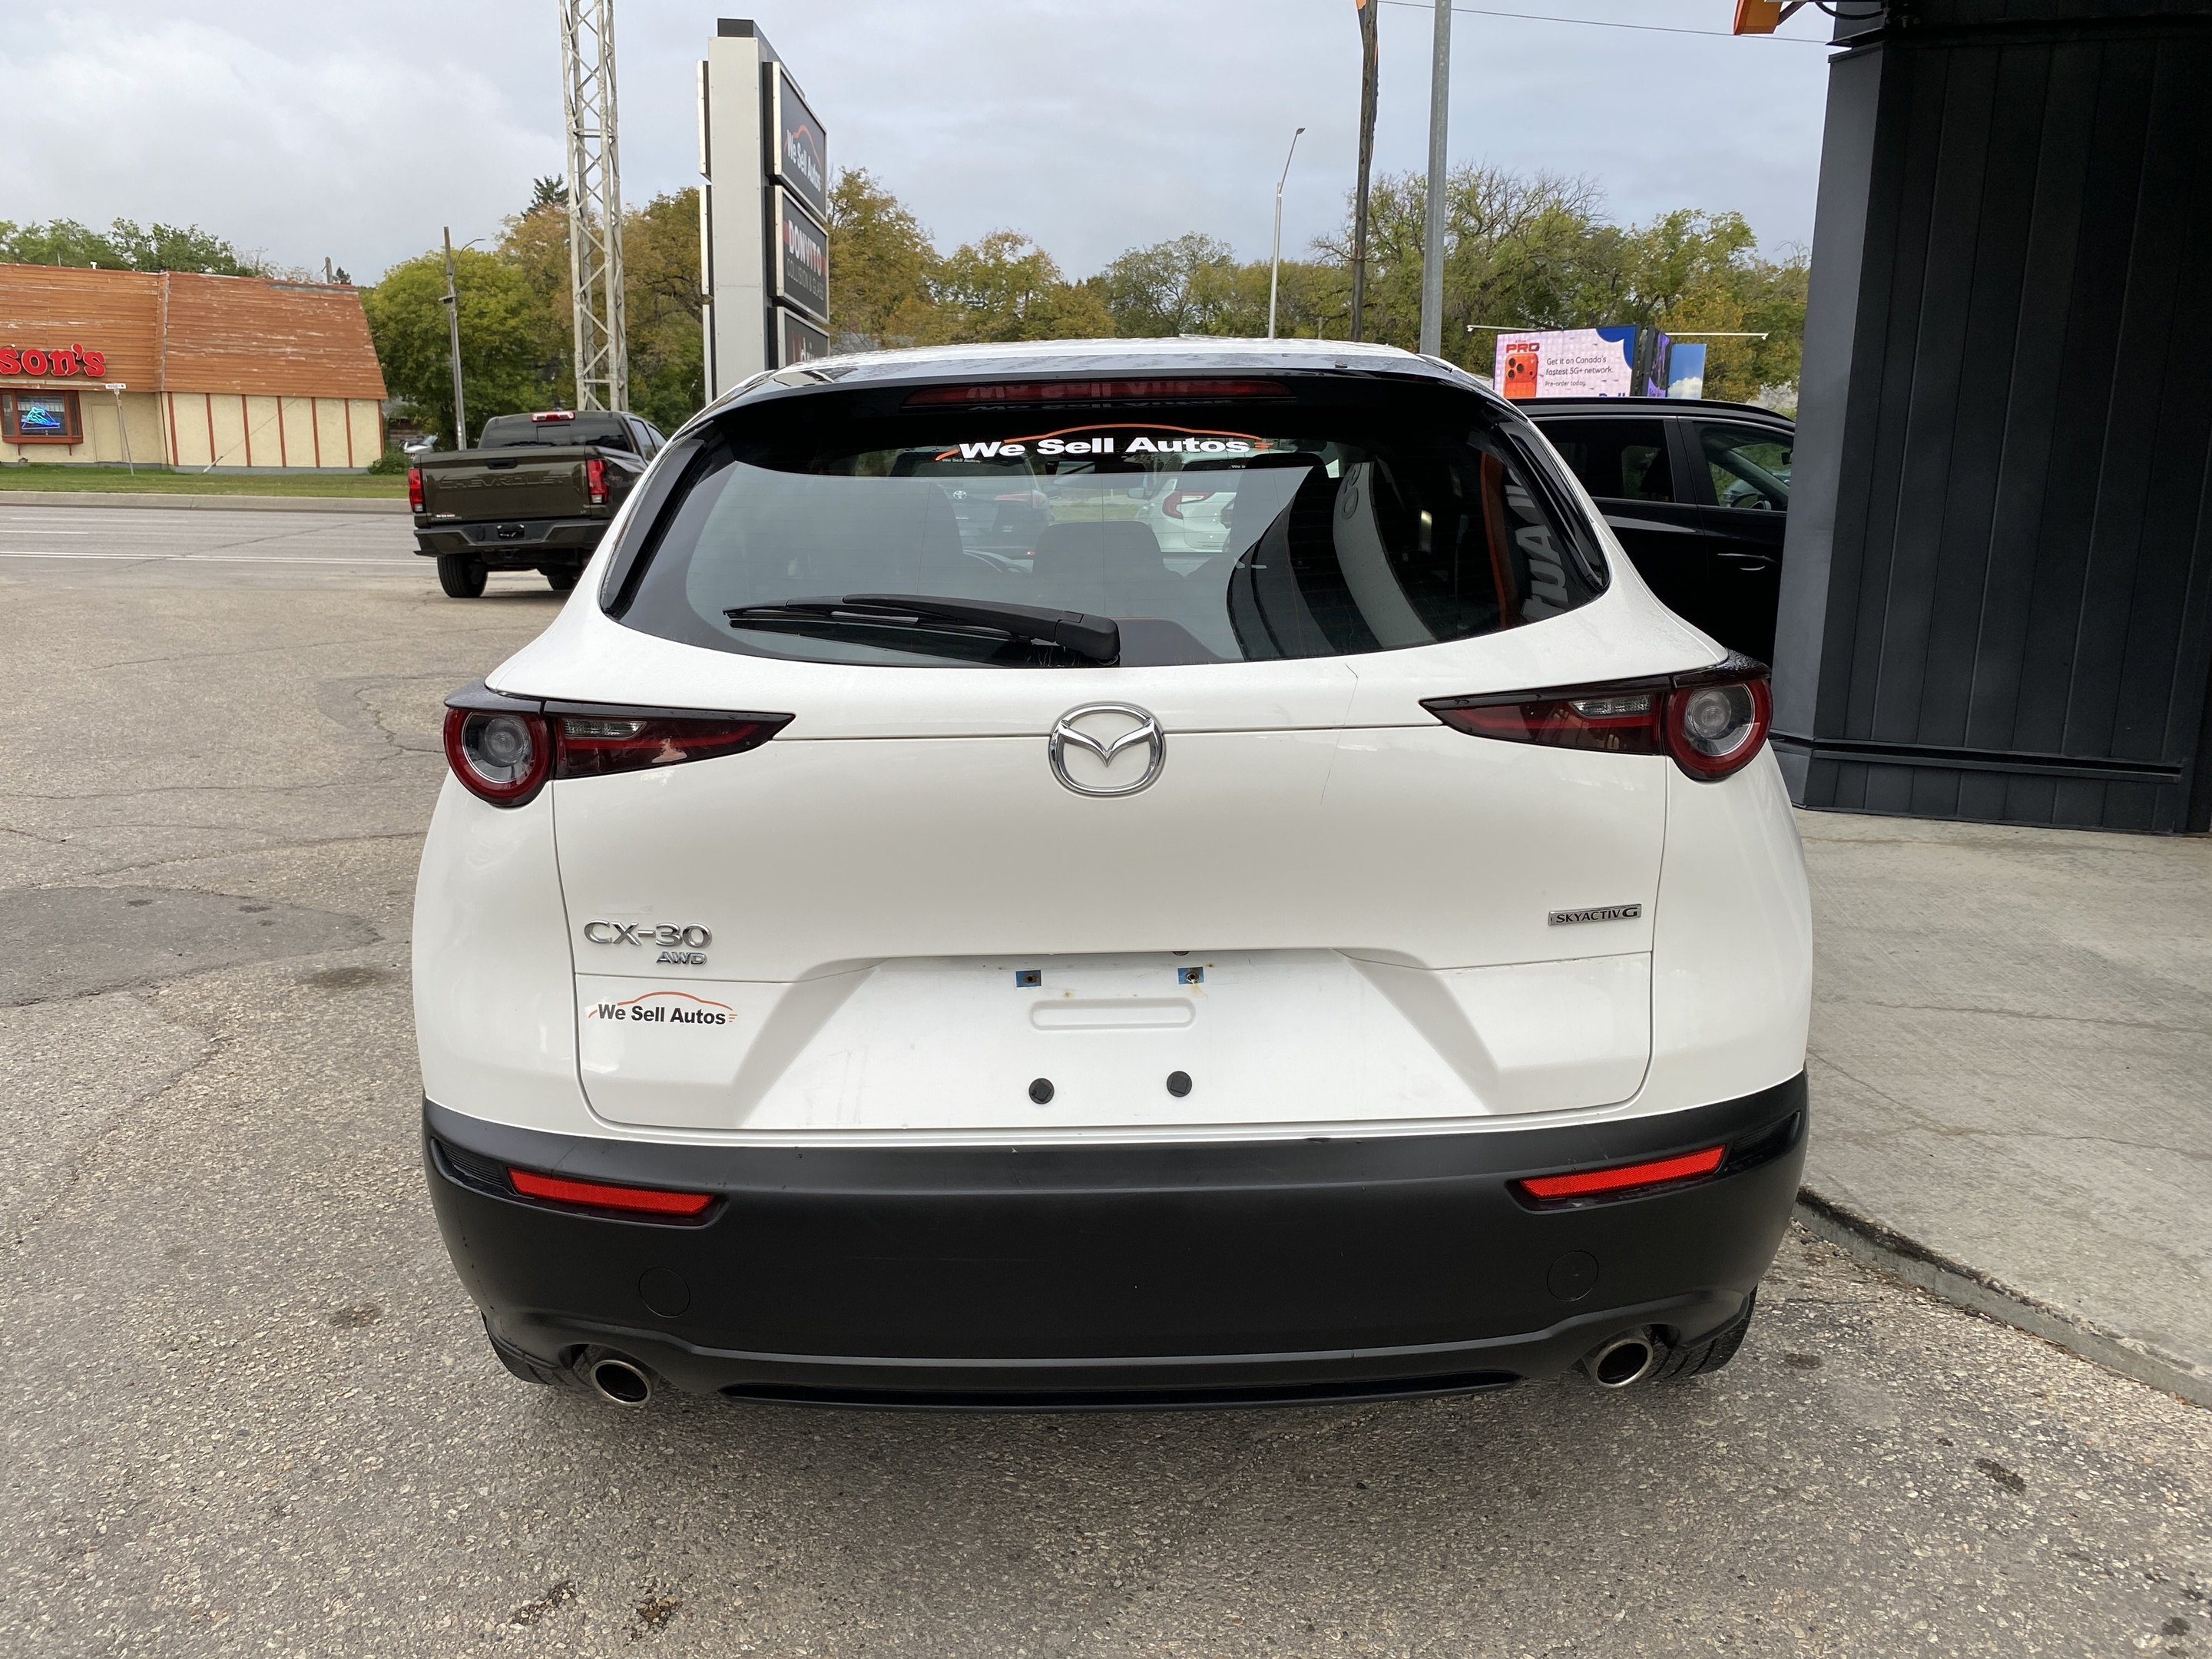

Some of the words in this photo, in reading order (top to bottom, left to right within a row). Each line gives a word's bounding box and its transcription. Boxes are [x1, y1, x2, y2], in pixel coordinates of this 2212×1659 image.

[787, 129, 796, 164] We
[797, 142, 807, 177] Sell
[788, 219, 822, 276] DONVITO
[1506, 343, 1540, 353] PRO
[1575, 356, 1607, 364] Canada's
[959, 442, 1025, 459] We
[1036, 437, 1114, 455] Sell
[1125, 436, 1250, 453] Autos
[439, 475, 569, 489] CHEVROLET
[584, 919, 713, 949] CX-30
[656, 952, 707, 965] AWD
[598, 1004, 626, 1020] We
[631, 1005, 665, 1022] Sell
[670, 1008, 726, 1025] Autos
